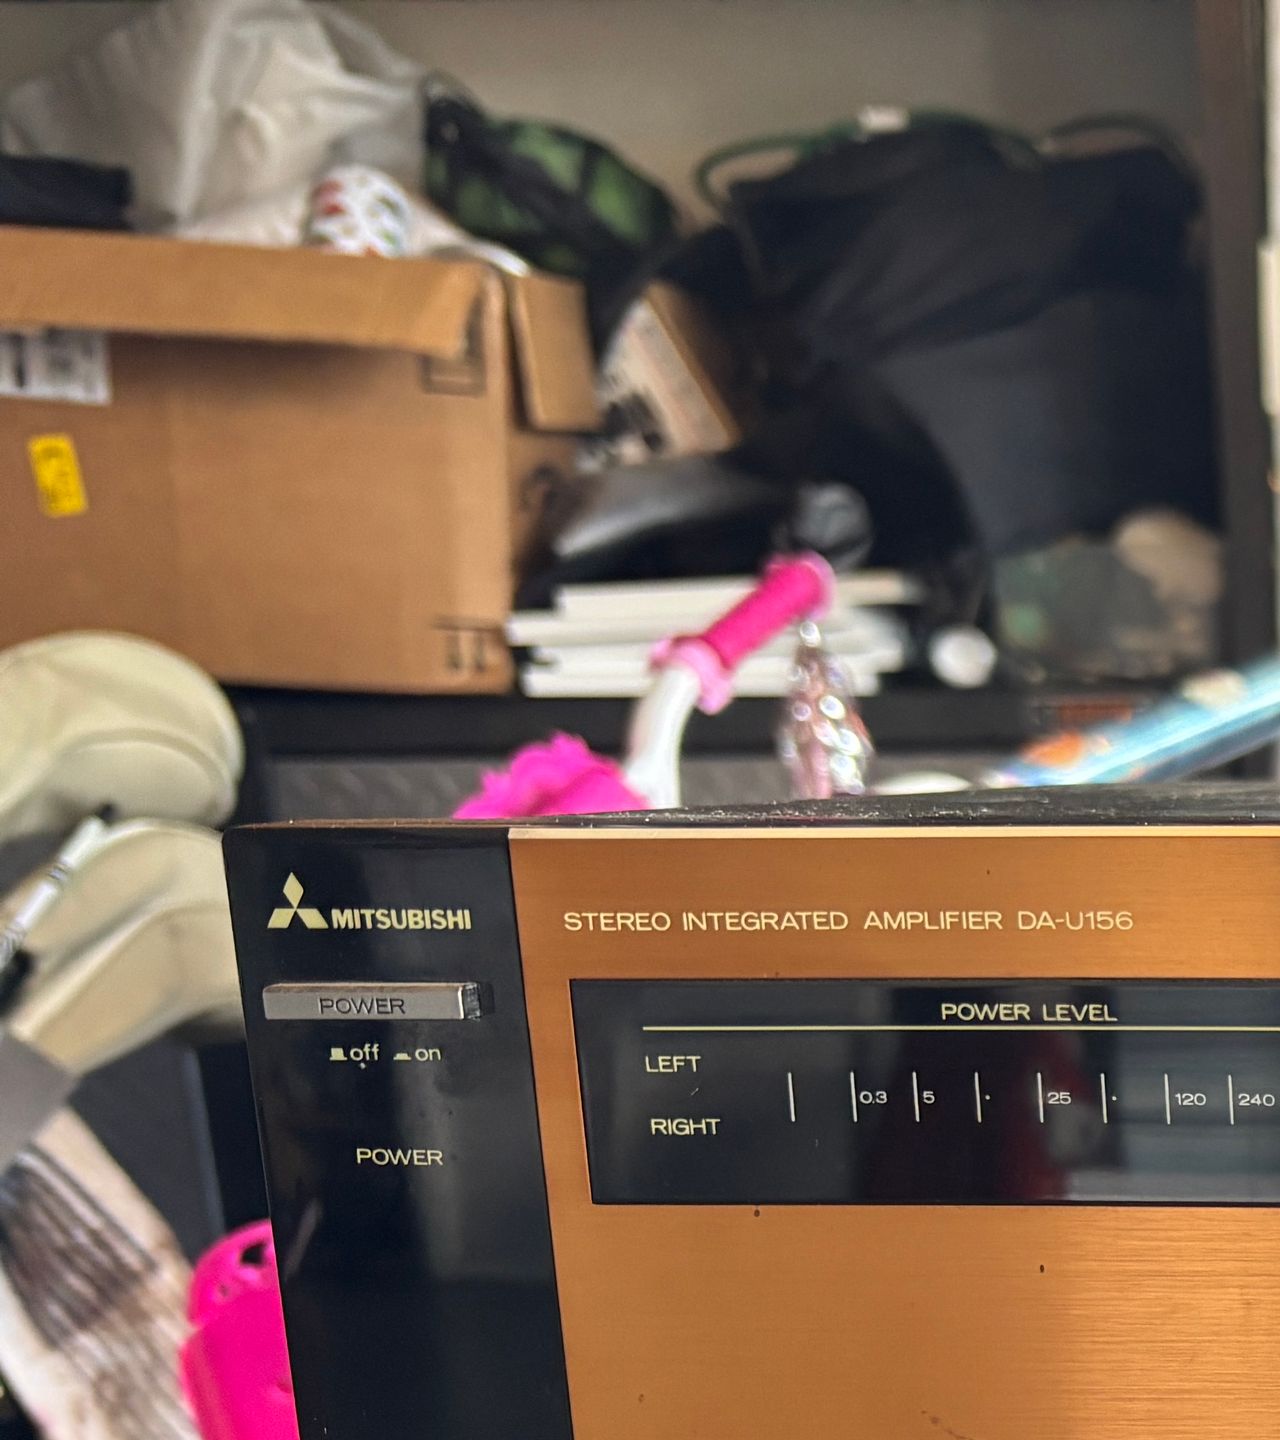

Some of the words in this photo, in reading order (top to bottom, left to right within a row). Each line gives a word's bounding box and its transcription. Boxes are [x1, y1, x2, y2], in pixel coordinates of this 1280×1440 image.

[330, 908, 472, 930] MITSUBISHI
[563, 911, 671, 932] STEREO
[682, 911, 849, 931] INTEGRATED
[863, 910, 1003, 930] AMPLIFIER
[1017, 910, 1134, 931] DA-U156
[319, 997, 406, 1015] POWER
[941, 1002, 1031, 1021] POWER
[1042, 1003, 1118, 1022] LEVEL
[349, 1043, 379, 1061] off
[414, 1048, 442, 1062] on
[645, 1055, 702, 1073] LEFT
[859, 1090, 888, 1104] 0.3
[922, 1090, 935, 1104] 5
[1046, 1091, 1072, 1105] 25
[1174, 1092, 1207, 1106] 120
[1238, 1093, 1276, 1107] 240
[650, 1118, 721, 1136] RIGHT
[356, 1147, 443, 1166] POWER
